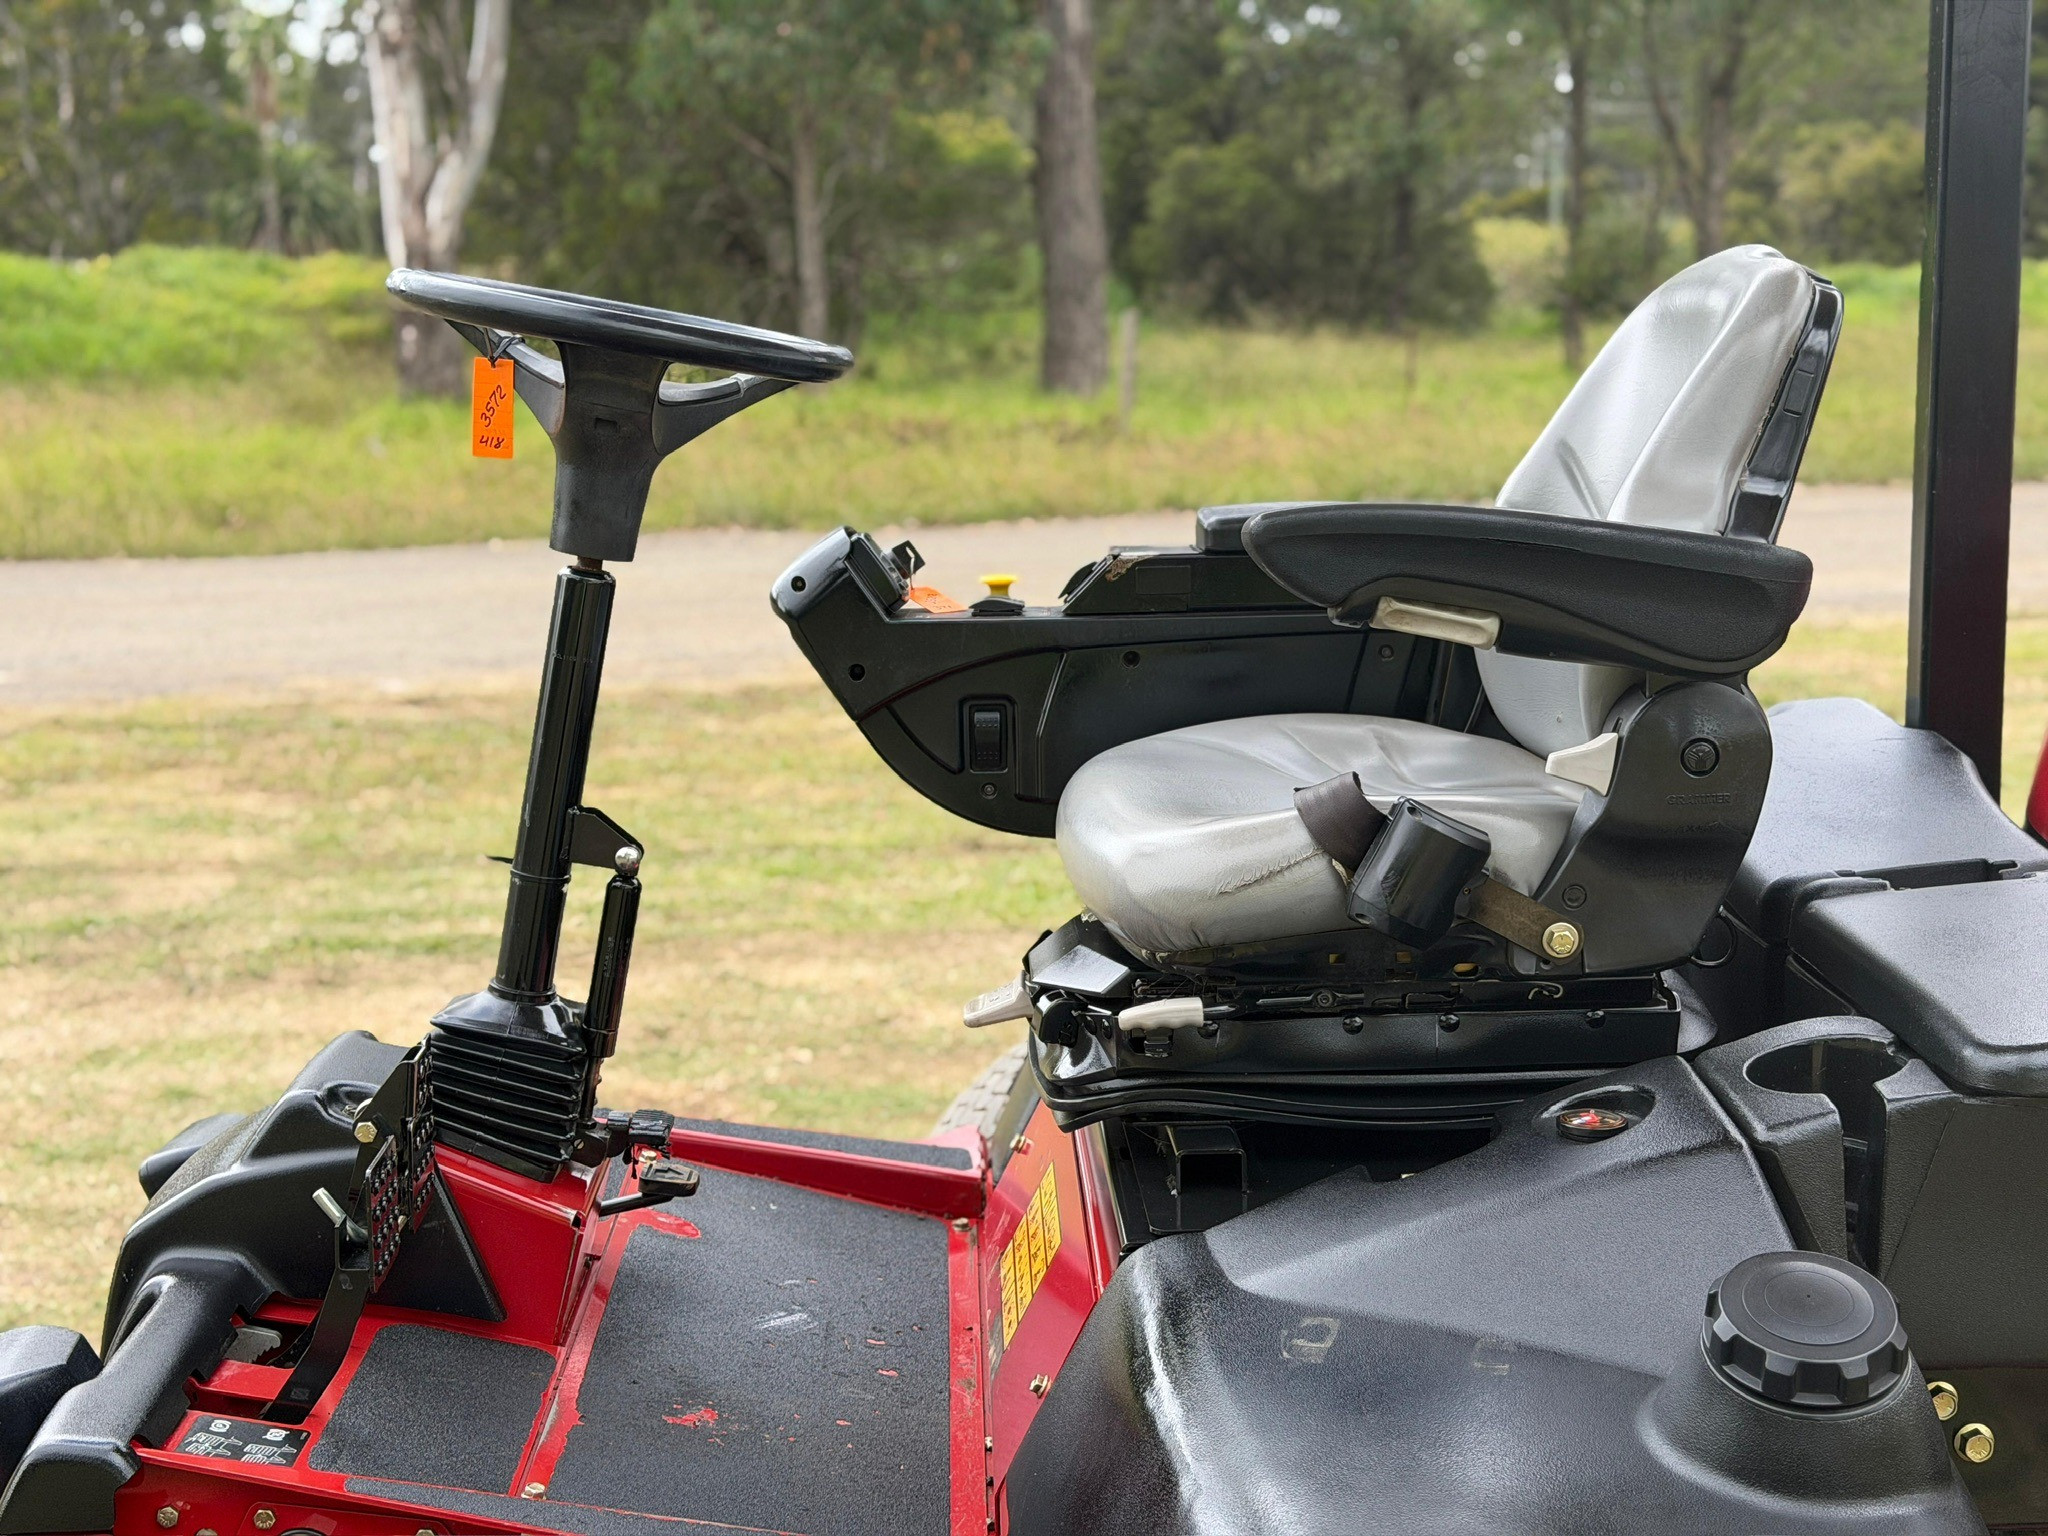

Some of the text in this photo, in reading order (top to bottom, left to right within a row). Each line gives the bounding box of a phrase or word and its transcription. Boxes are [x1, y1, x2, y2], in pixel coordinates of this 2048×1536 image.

[480, 384, 506, 428] 3572
[479, 434, 505, 449] 418
[1665, 792, 1731, 806] GRAMMER
